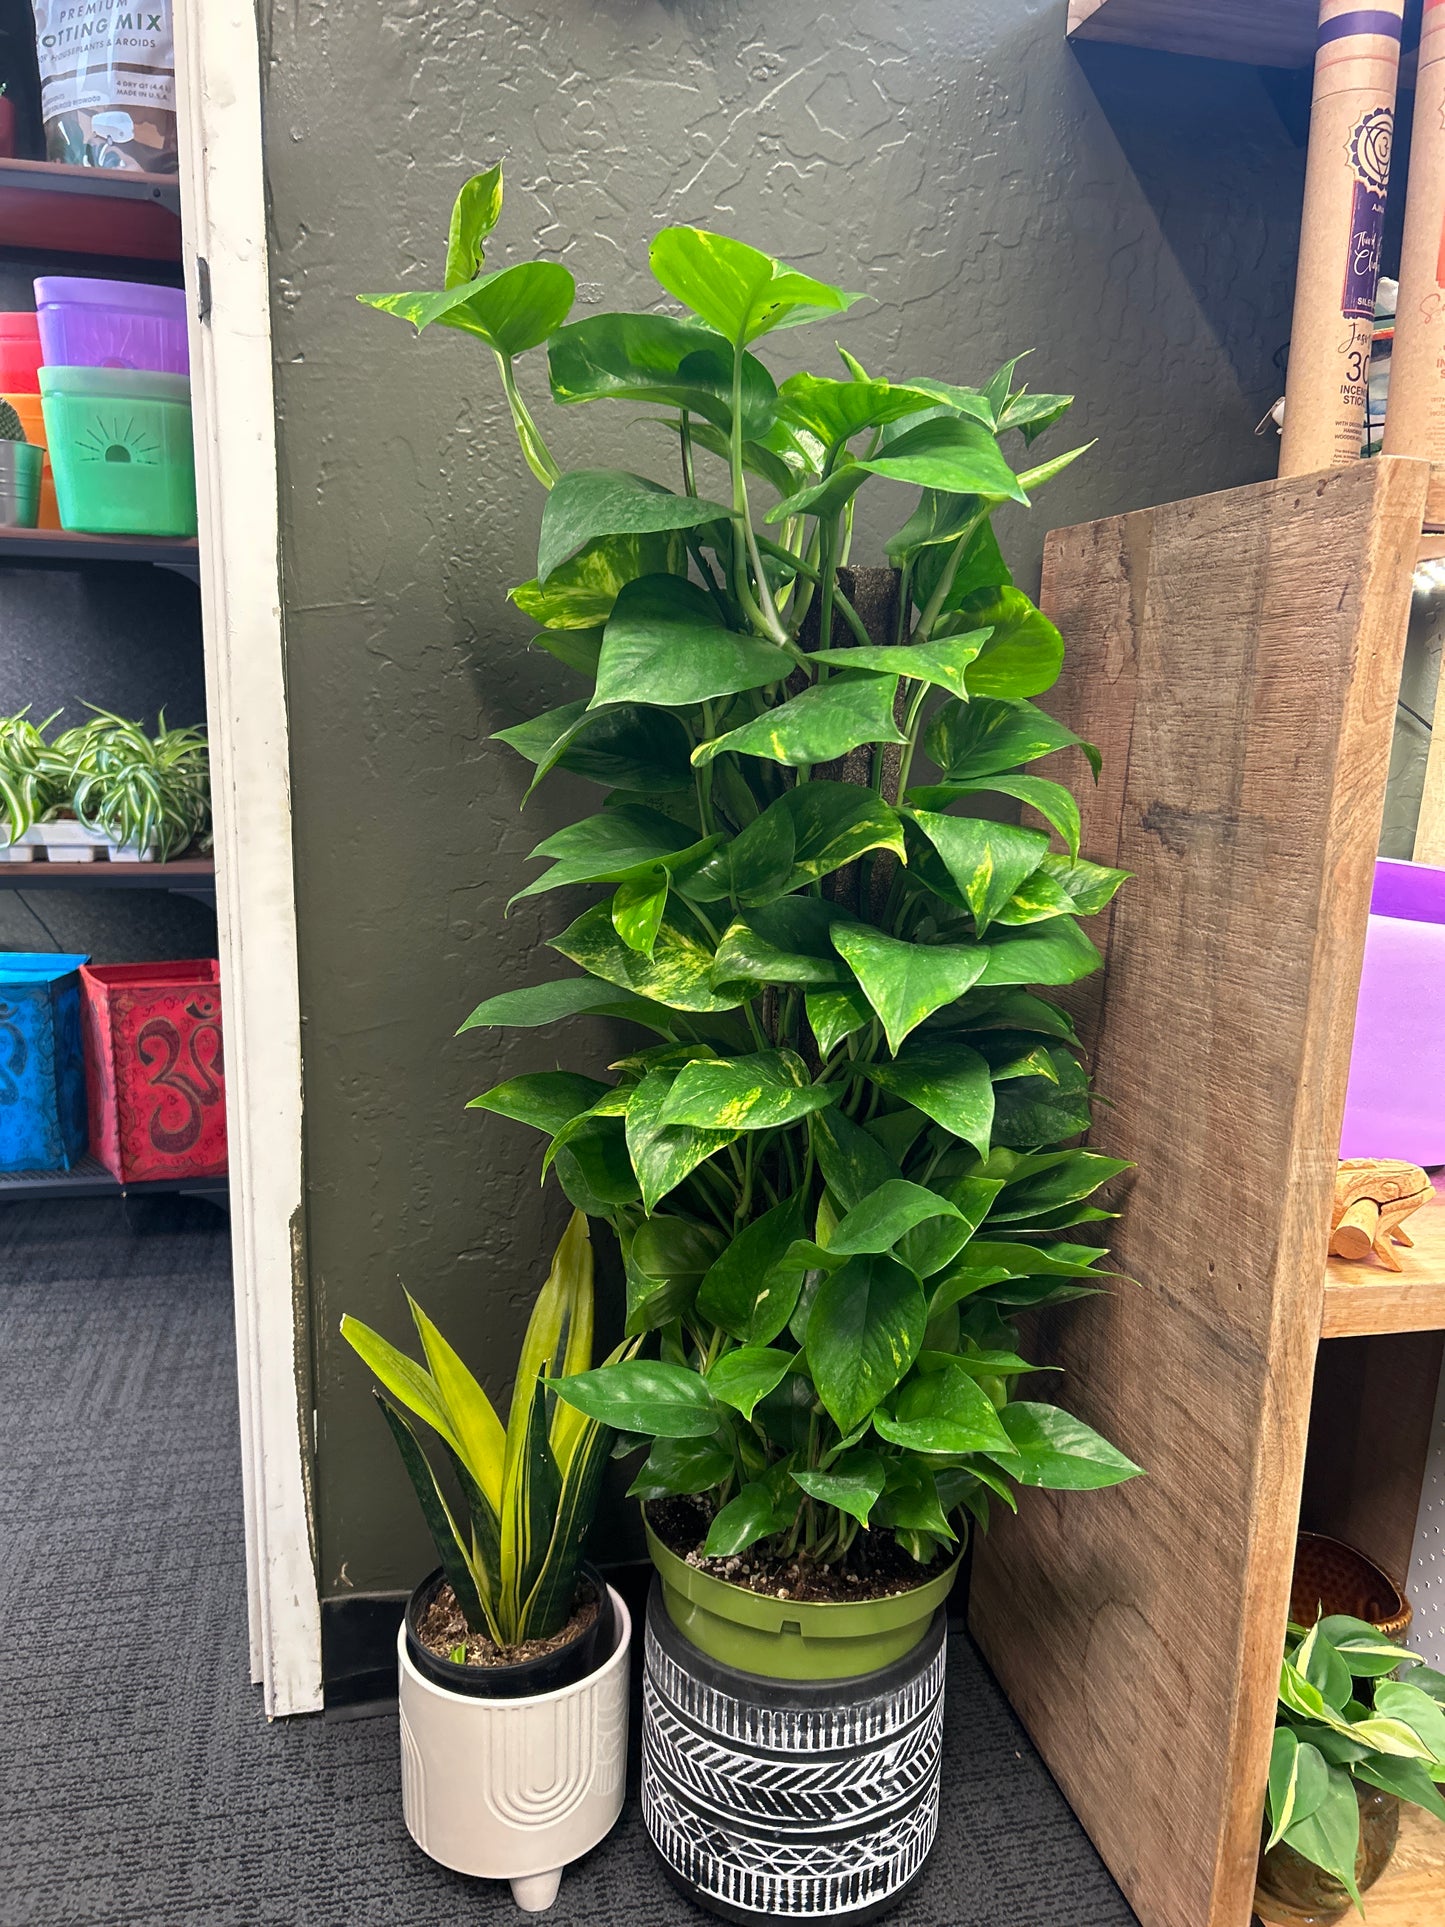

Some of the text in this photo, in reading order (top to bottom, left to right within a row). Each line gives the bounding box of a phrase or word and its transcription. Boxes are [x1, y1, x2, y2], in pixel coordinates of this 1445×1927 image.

[42, 13, 161, 47] OTTING MIX
[51, 41, 104, 61] HOUSEPLANTS
[115, 38, 156, 48] AROIDS
[116, 89, 137, 97] MADE
